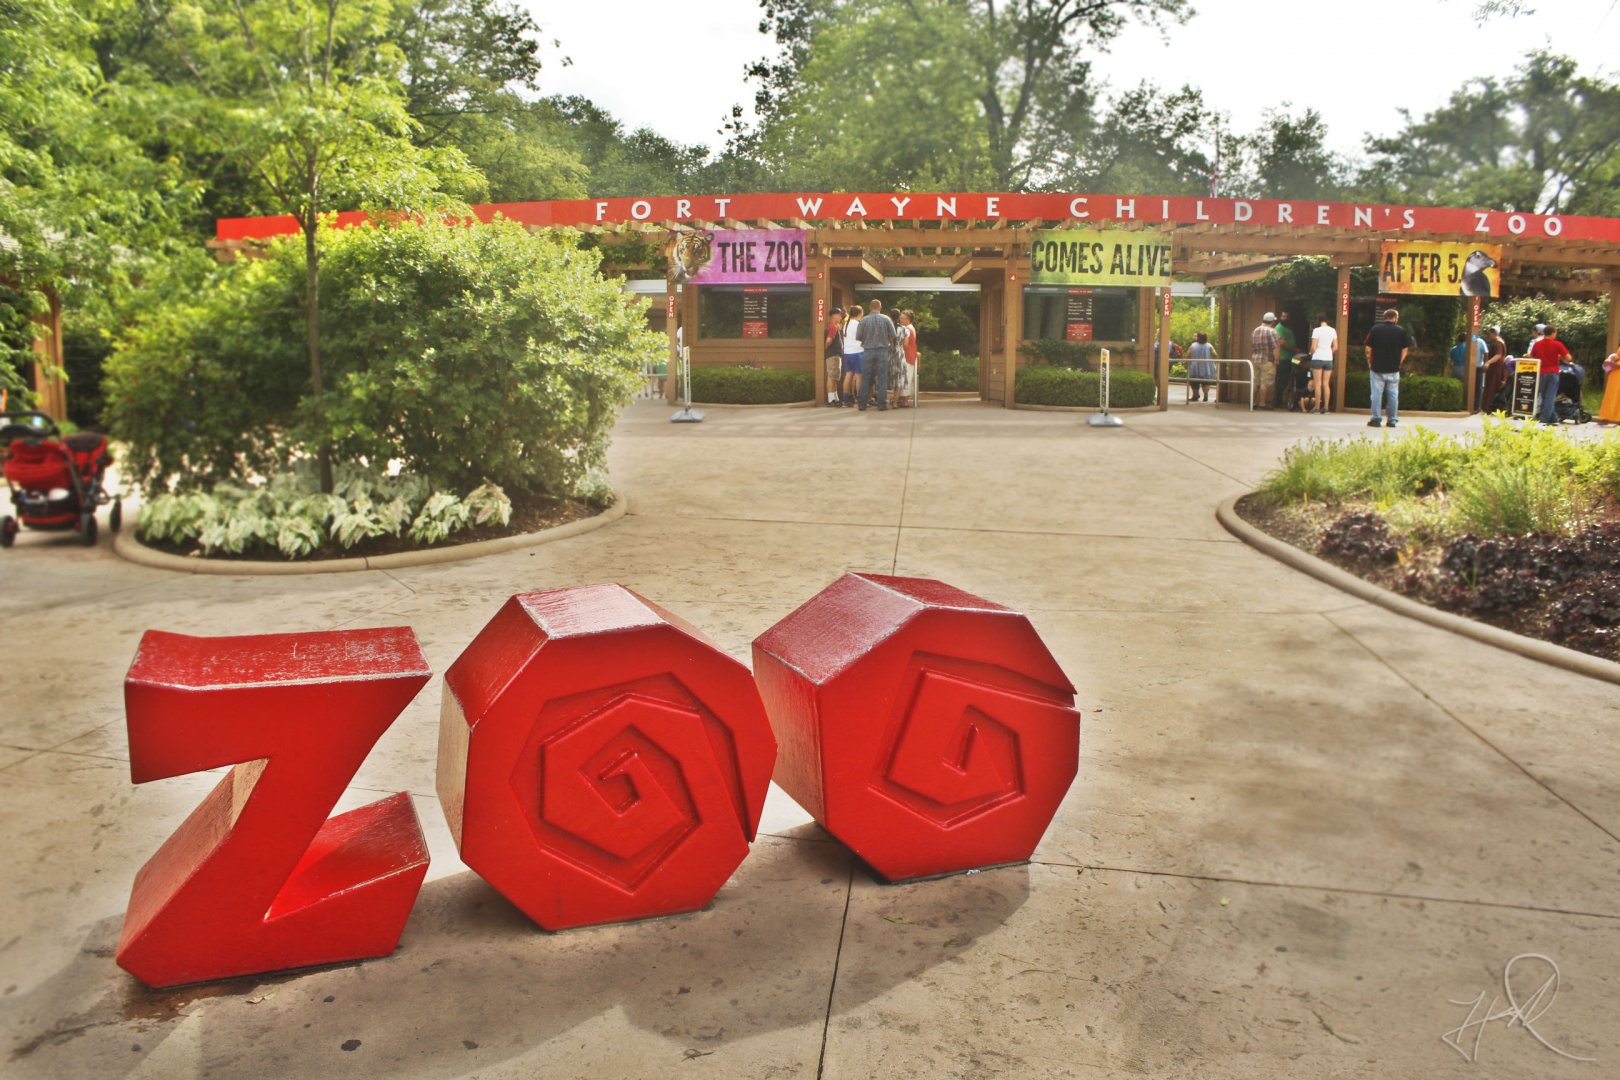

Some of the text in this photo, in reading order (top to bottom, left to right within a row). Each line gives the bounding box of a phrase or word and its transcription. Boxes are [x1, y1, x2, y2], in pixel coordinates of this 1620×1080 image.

[595, 196, 1563, 237] FORT WAYNE CHILDREN'S ZOO
[717, 240, 803, 273] THE ZOO
[1031, 239, 1171, 277] COMES ALIVE
[1382, 252, 1441, 283] AFTER
[115, 572, 1081, 990] ZOO
